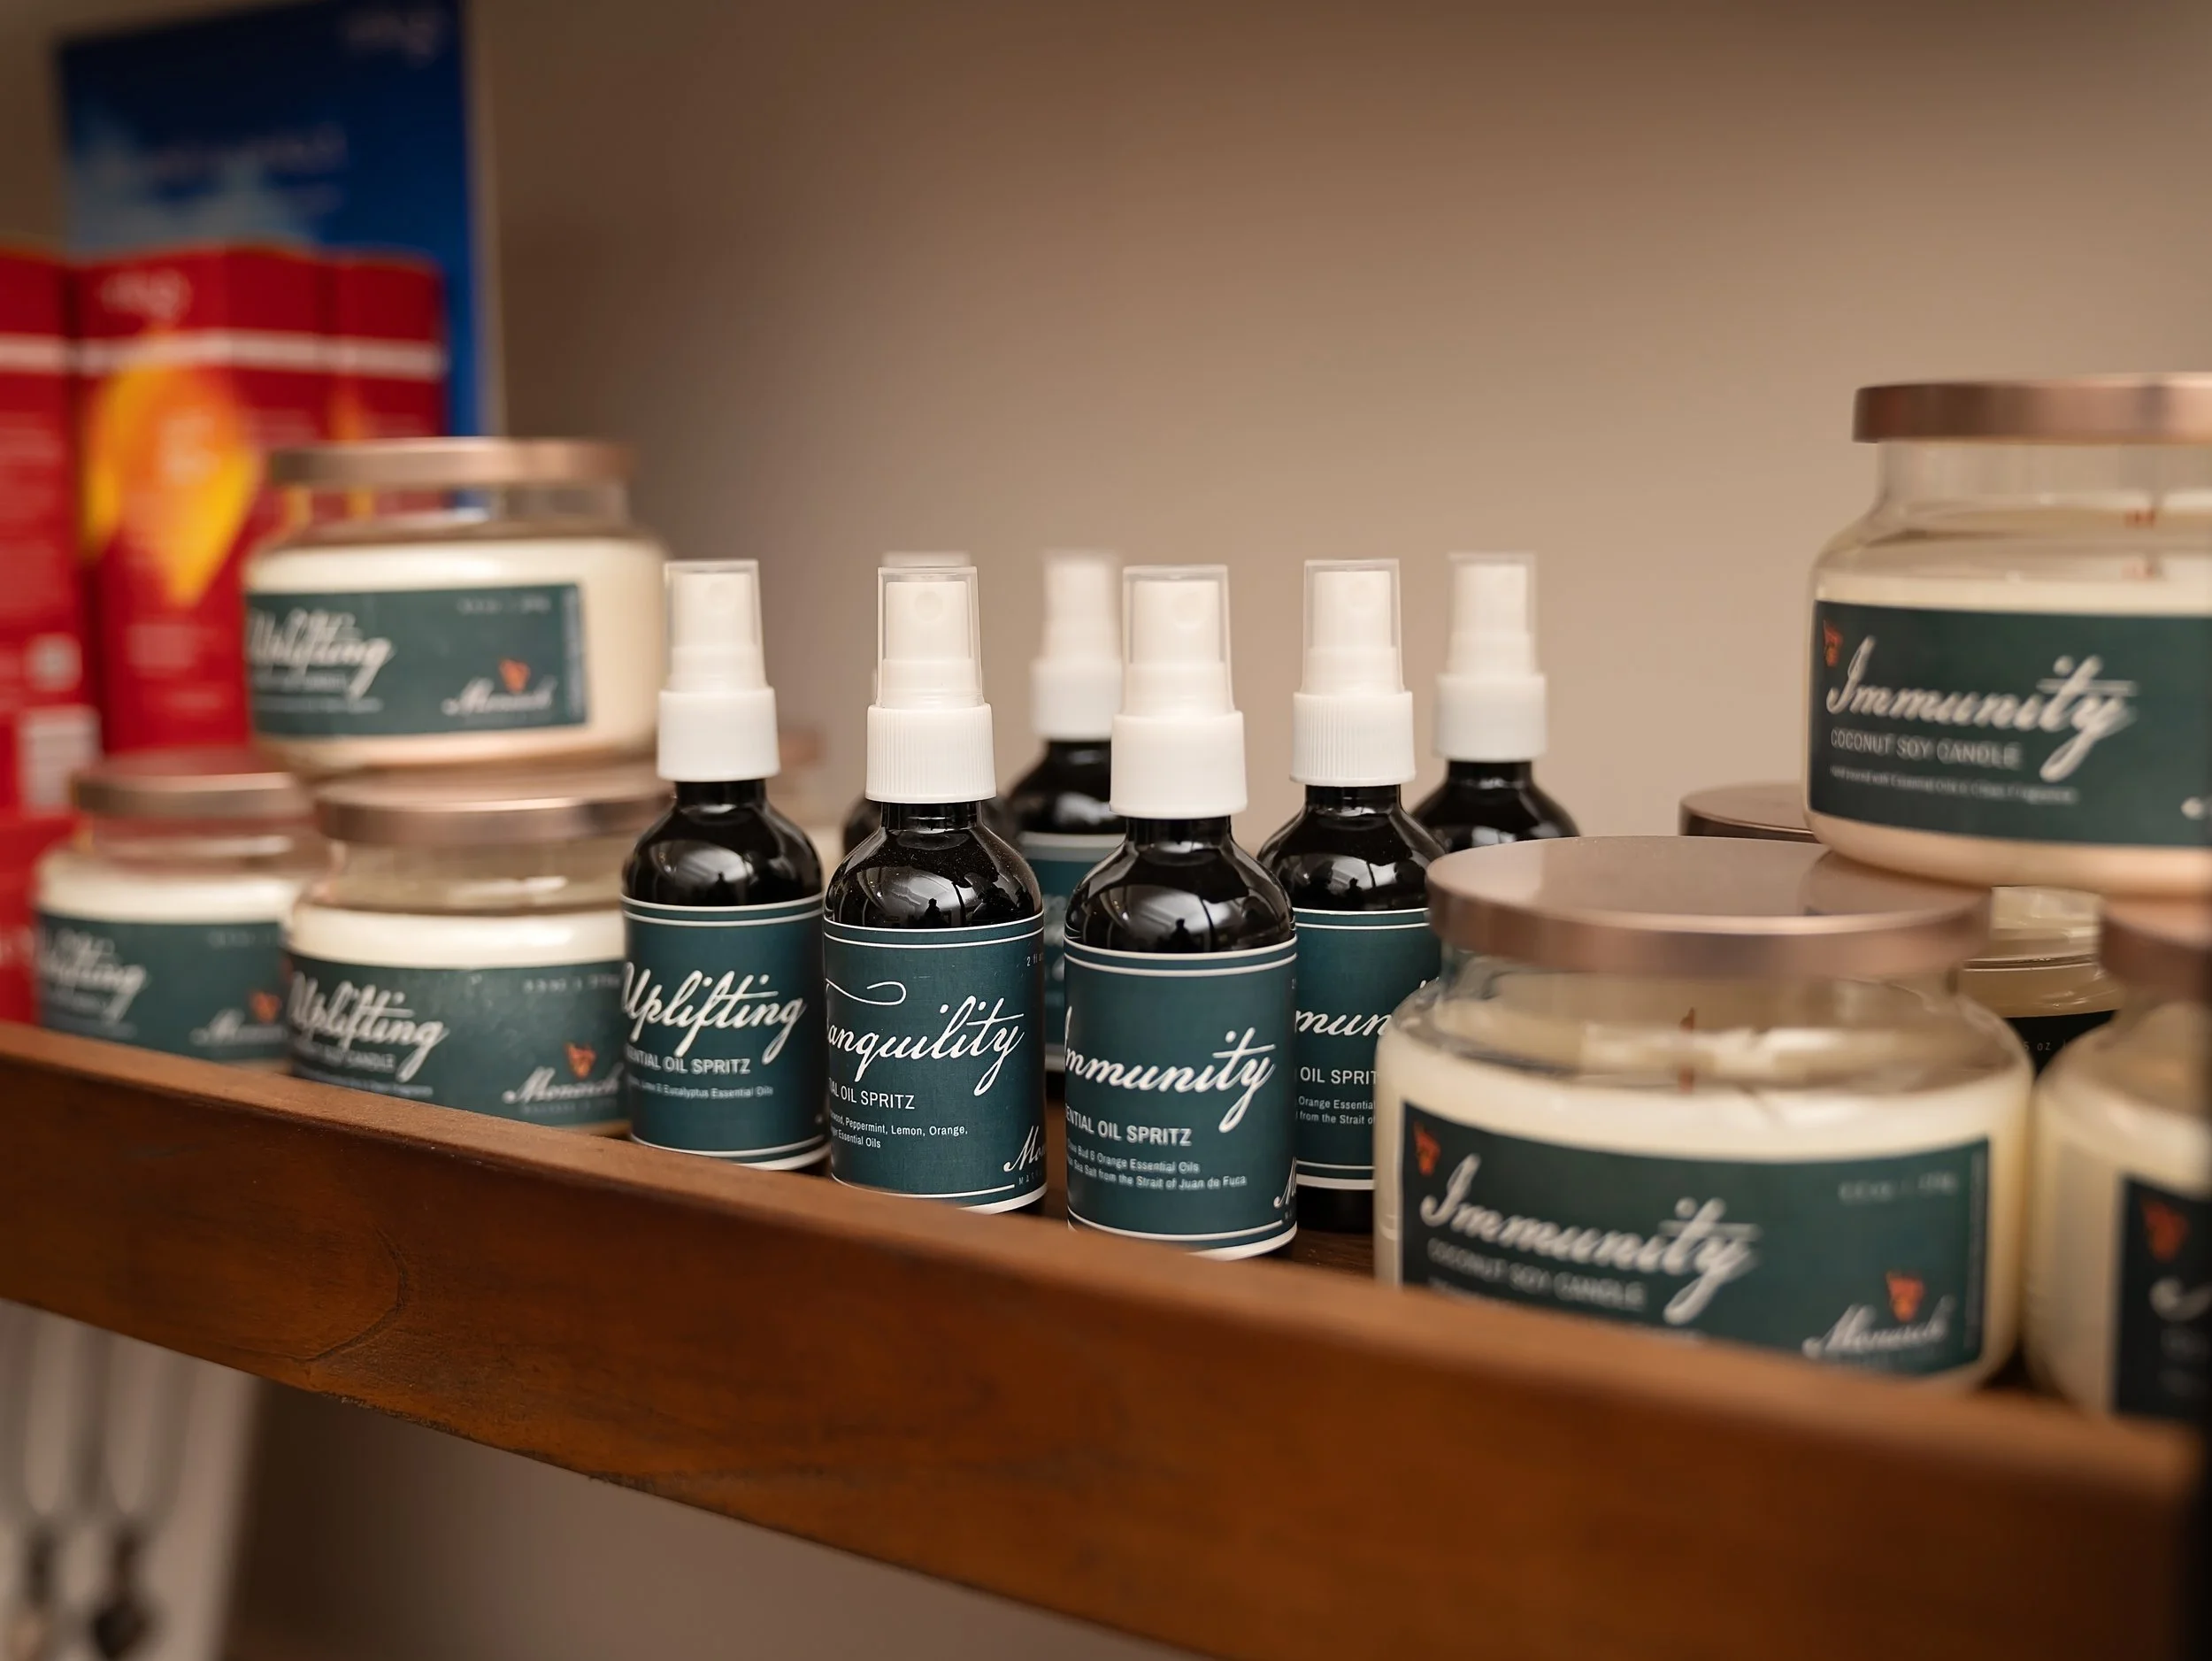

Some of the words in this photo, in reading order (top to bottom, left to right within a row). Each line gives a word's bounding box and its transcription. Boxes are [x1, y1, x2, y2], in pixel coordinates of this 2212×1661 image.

[1826, 634, 2139, 782] Immunity
[1830, 727, 1895, 756] COCONUT
[1896, 734, 1936, 760] SOY
[1936, 737, 2024, 771] CANDLE
[623, 961, 807, 1065] Uplifting
[287, 971, 450, 1083] Uplifting
[664, 1057, 688, 1073] OIL
[690, 1058, 751, 1074] SPRITZ
[1300, 1066, 1325, 1083] OIL
[1331, 1069, 1378, 1085] SPRIT
[664, 1084, 709, 1098] Eucalyptus
[710, 1088, 753, 1099] Essential
[841, 1085, 857, 1103] OIL
[861, 1090, 915, 1110] SPRITZ
[1298, 1096, 1331, 1110] Orange
[846, 1117, 887, 1135] Peppermint,
[891, 1125, 925, 1136] Lemon,
[1300, 1111, 1319, 1122] from
[1322, 1113, 1336, 1124] the
[1340, 1114, 1364, 1126] Strait
[838, 1129, 864, 1145] Essential
[865, 1137, 881, 1149] Oils
[1098, 1120, 1122, 1142] OIL
[1126, 1125, 1193, 1146] SPRITZ
[1097, 1152, 1127, 1170] Orange
[1130, 1158, 1177, 1173] Essential
[1179, 1161, 1201, 1174] Oils
[1098, 1169, 1117, 1182] from
[1118, 1173, 1133, 1186] the
[1136, 1175, 1164, 1189] Strait
[1165, 1178, 1178, 1190] of
[1179, 1178, 1204, 1191] Juan
[1207, 1177, 1221, 1190] de
[1223, 1175, 1248, 1187] Fuca
[1419, 1153, 1764, 1326] Immunity
